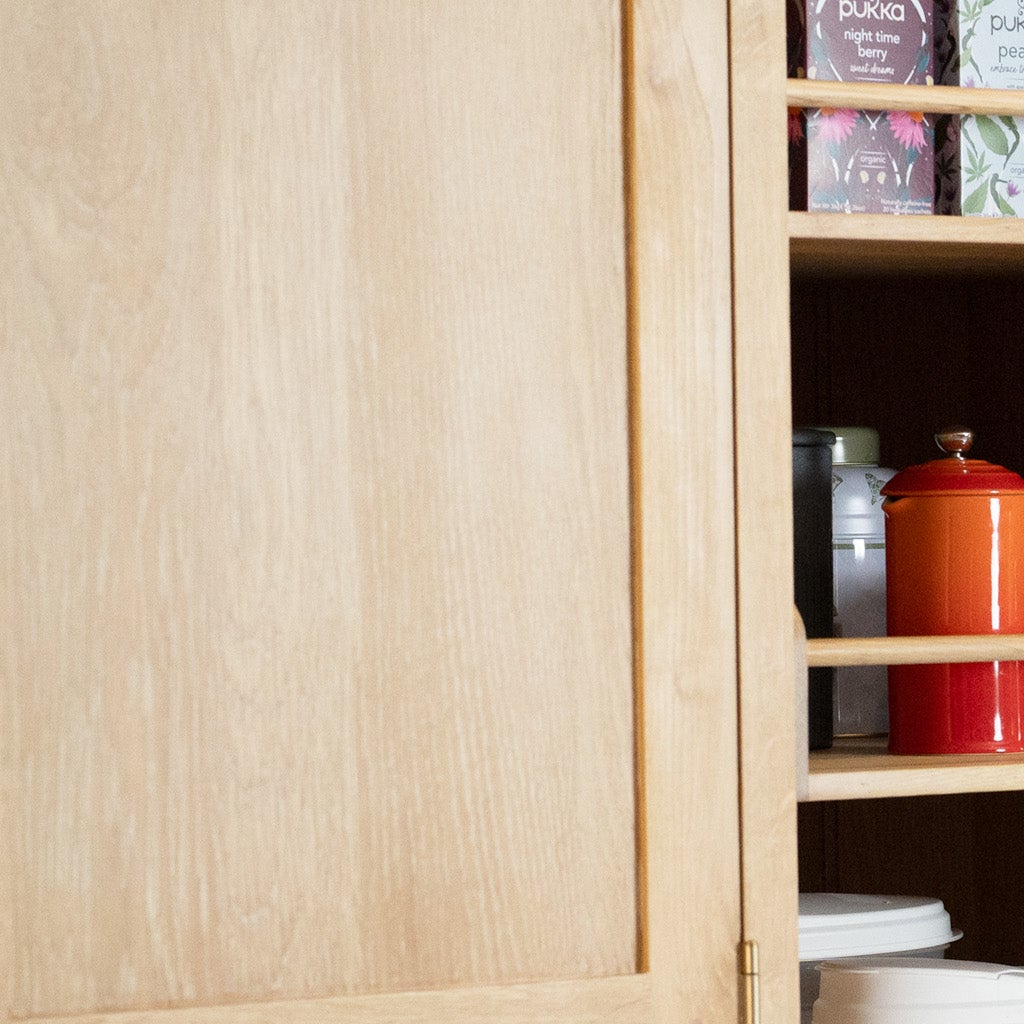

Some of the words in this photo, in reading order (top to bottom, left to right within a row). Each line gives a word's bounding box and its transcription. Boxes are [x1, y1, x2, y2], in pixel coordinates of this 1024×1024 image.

[839, 0, 905, 21] pukka
[844, 28, 873, 44] night
[876, 31, 901, 44] time
[858, 45, 887, 62] berry
[990, 64, 1017, 73] embrace
[860, 155, 886, 165] organic
